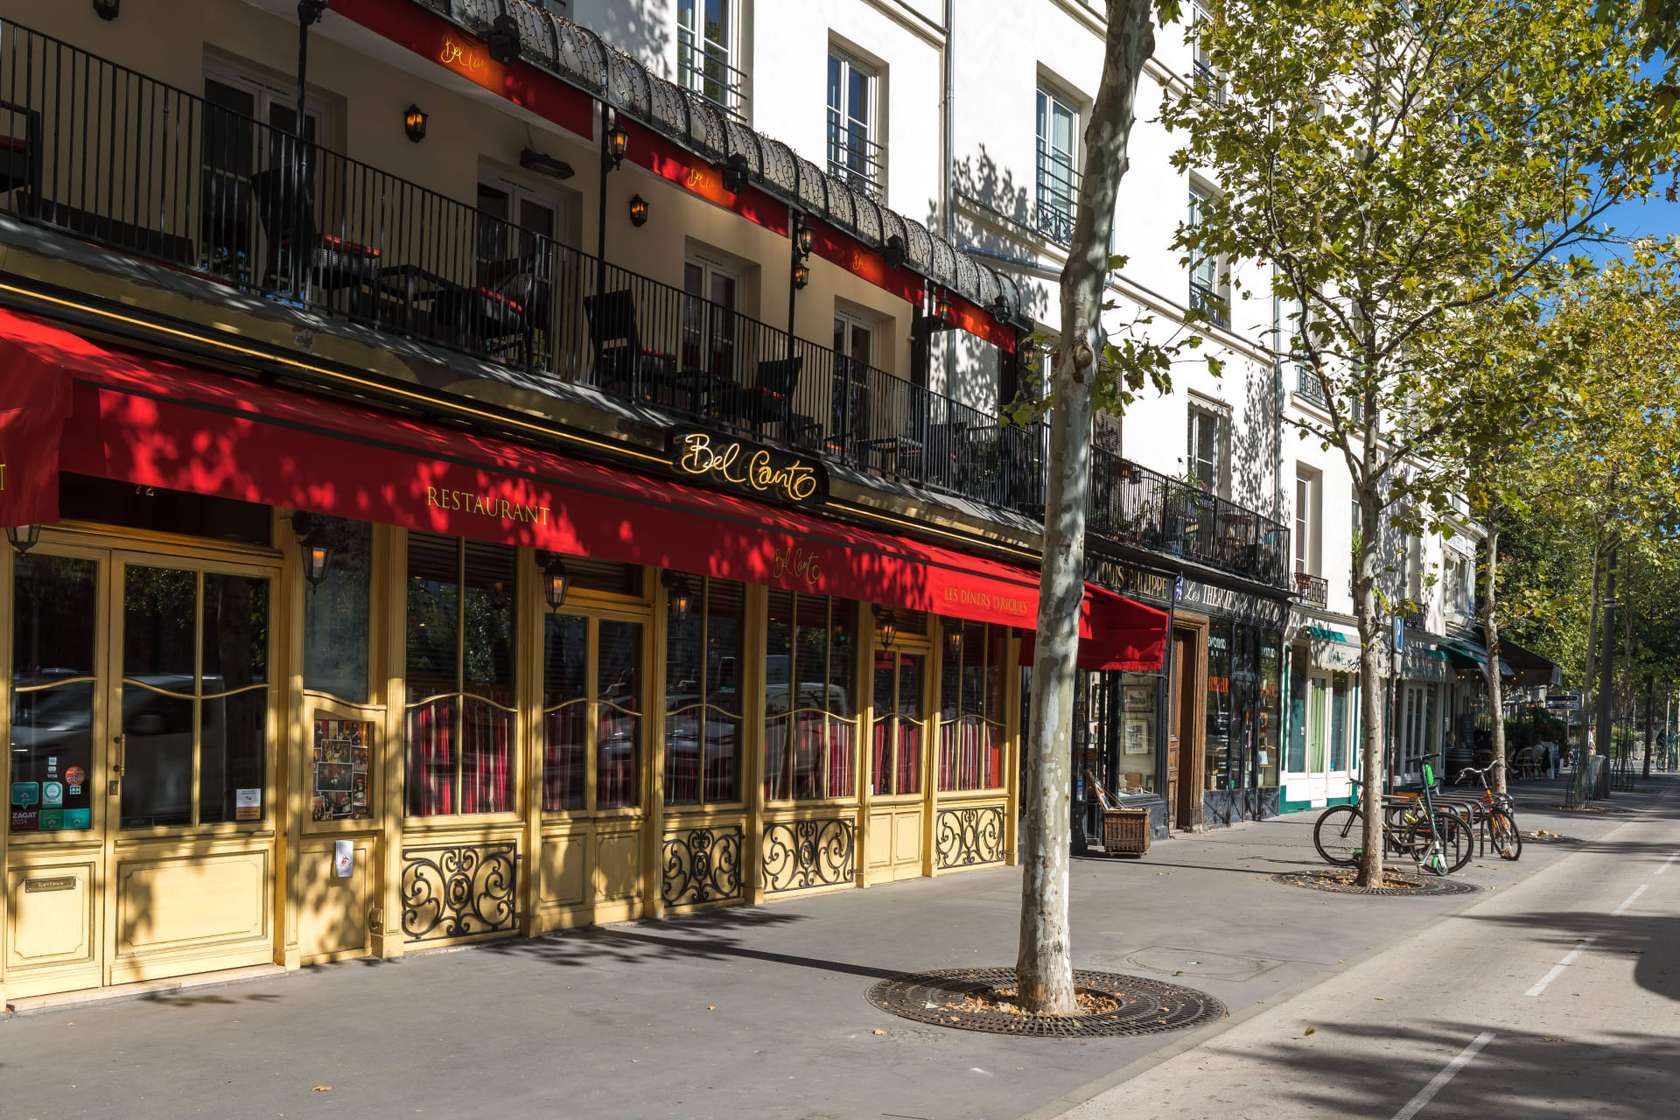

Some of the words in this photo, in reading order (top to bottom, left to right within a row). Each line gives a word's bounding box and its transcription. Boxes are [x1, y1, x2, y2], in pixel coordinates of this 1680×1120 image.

[682, 433, 746, 483] Bel
[749, 450, 817, 501] Canto
[426, 486, 551, 526] RESTAURANT
[944, 585, 959, 602] LES
[1184, 580, 1201, 603] Les
